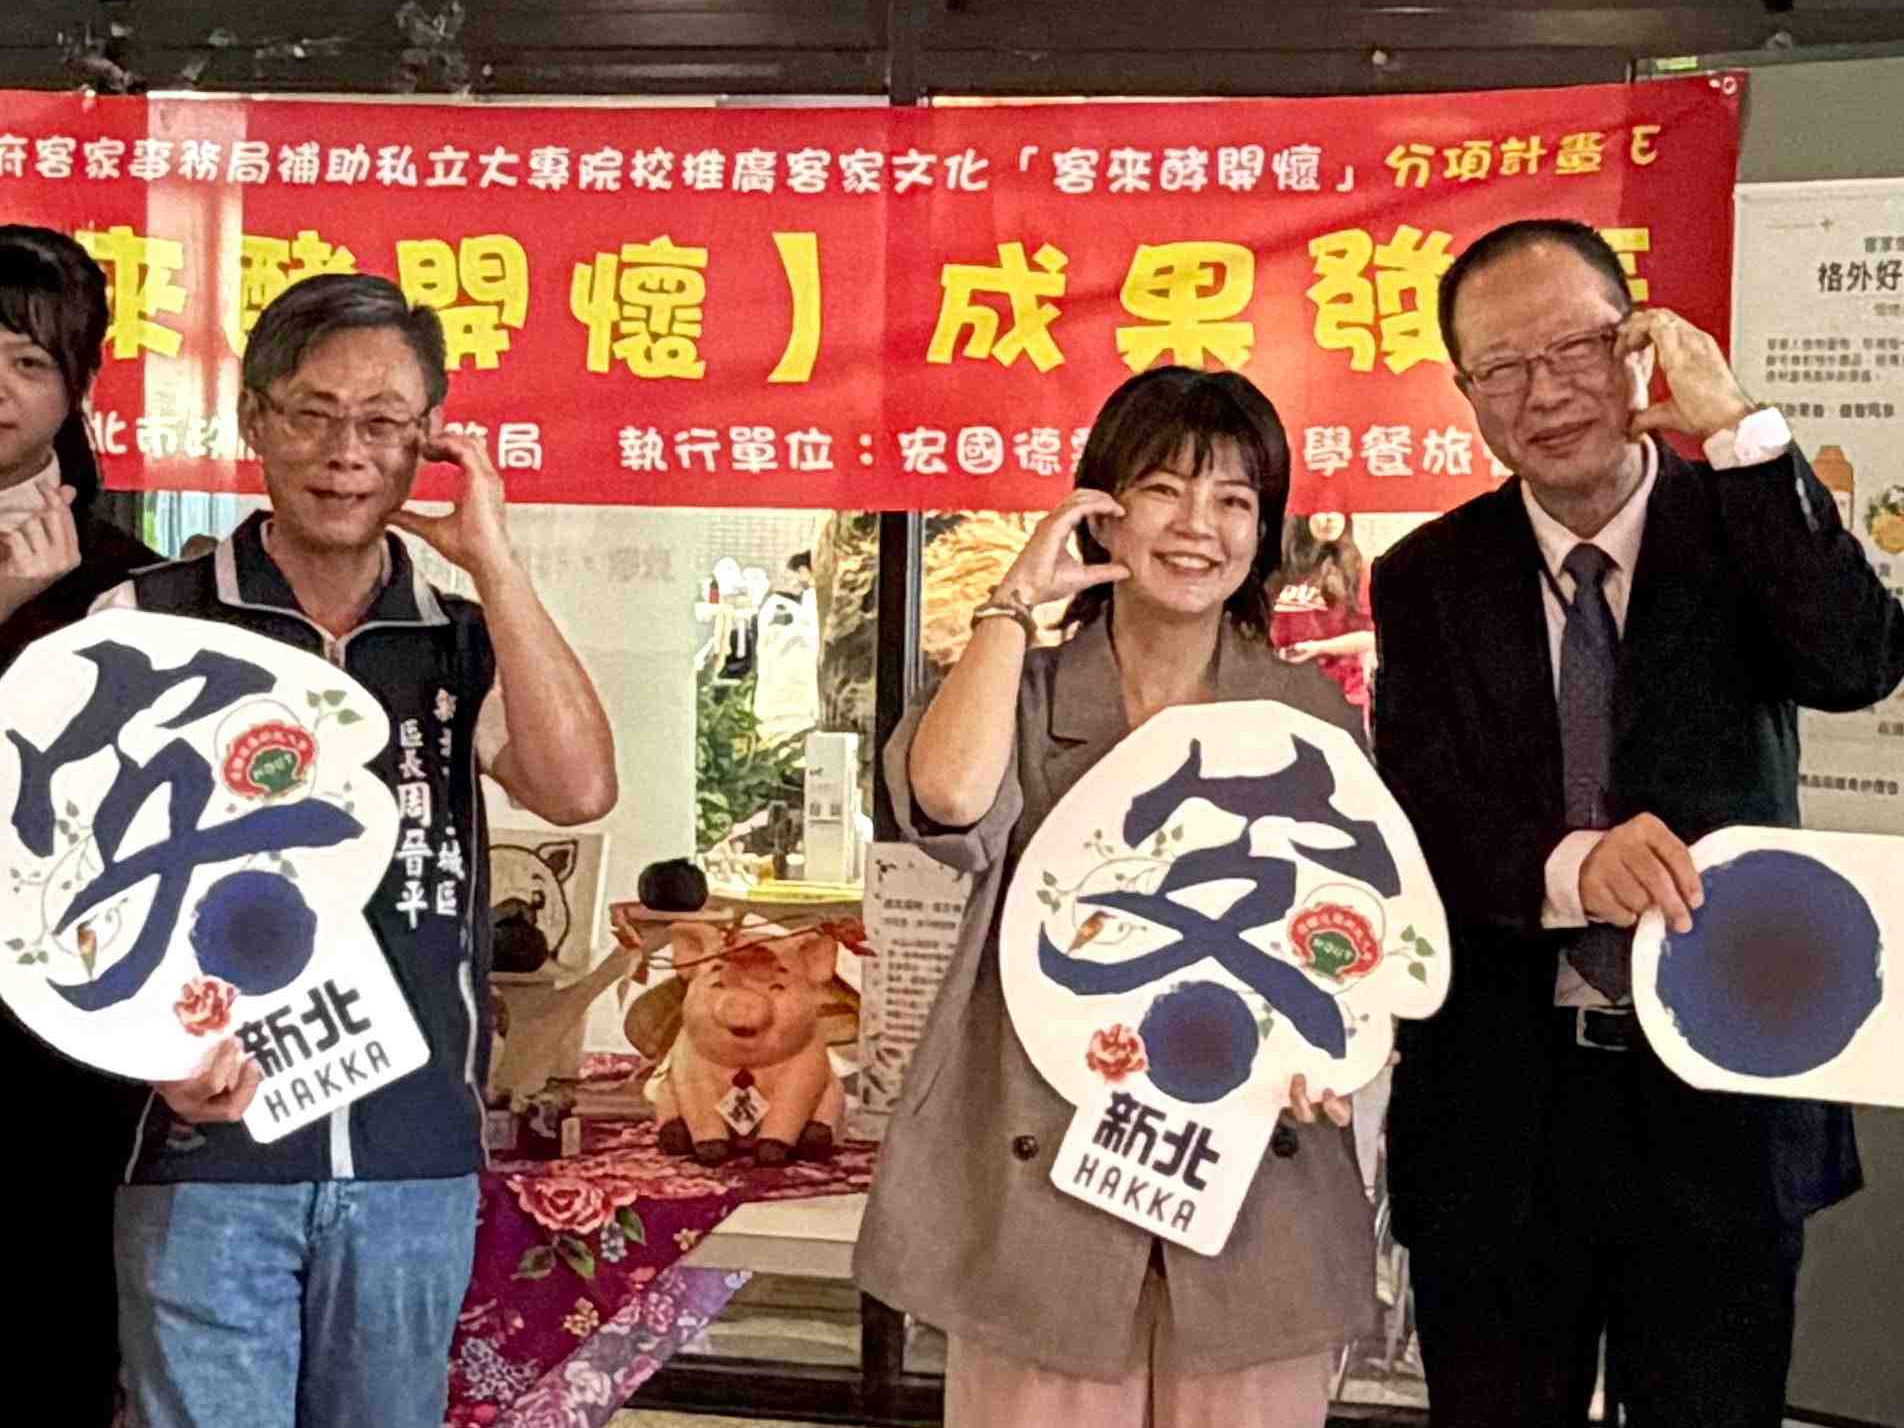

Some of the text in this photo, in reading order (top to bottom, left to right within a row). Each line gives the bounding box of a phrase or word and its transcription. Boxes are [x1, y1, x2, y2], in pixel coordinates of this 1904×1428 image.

[234, 979, 372, 1078] 新北
[263, 1040, 391, 1123] HAKKA
[1092, 1090, 1221, 1192] 新北
[1073, 1152, 1196, 1233] HAKKA
